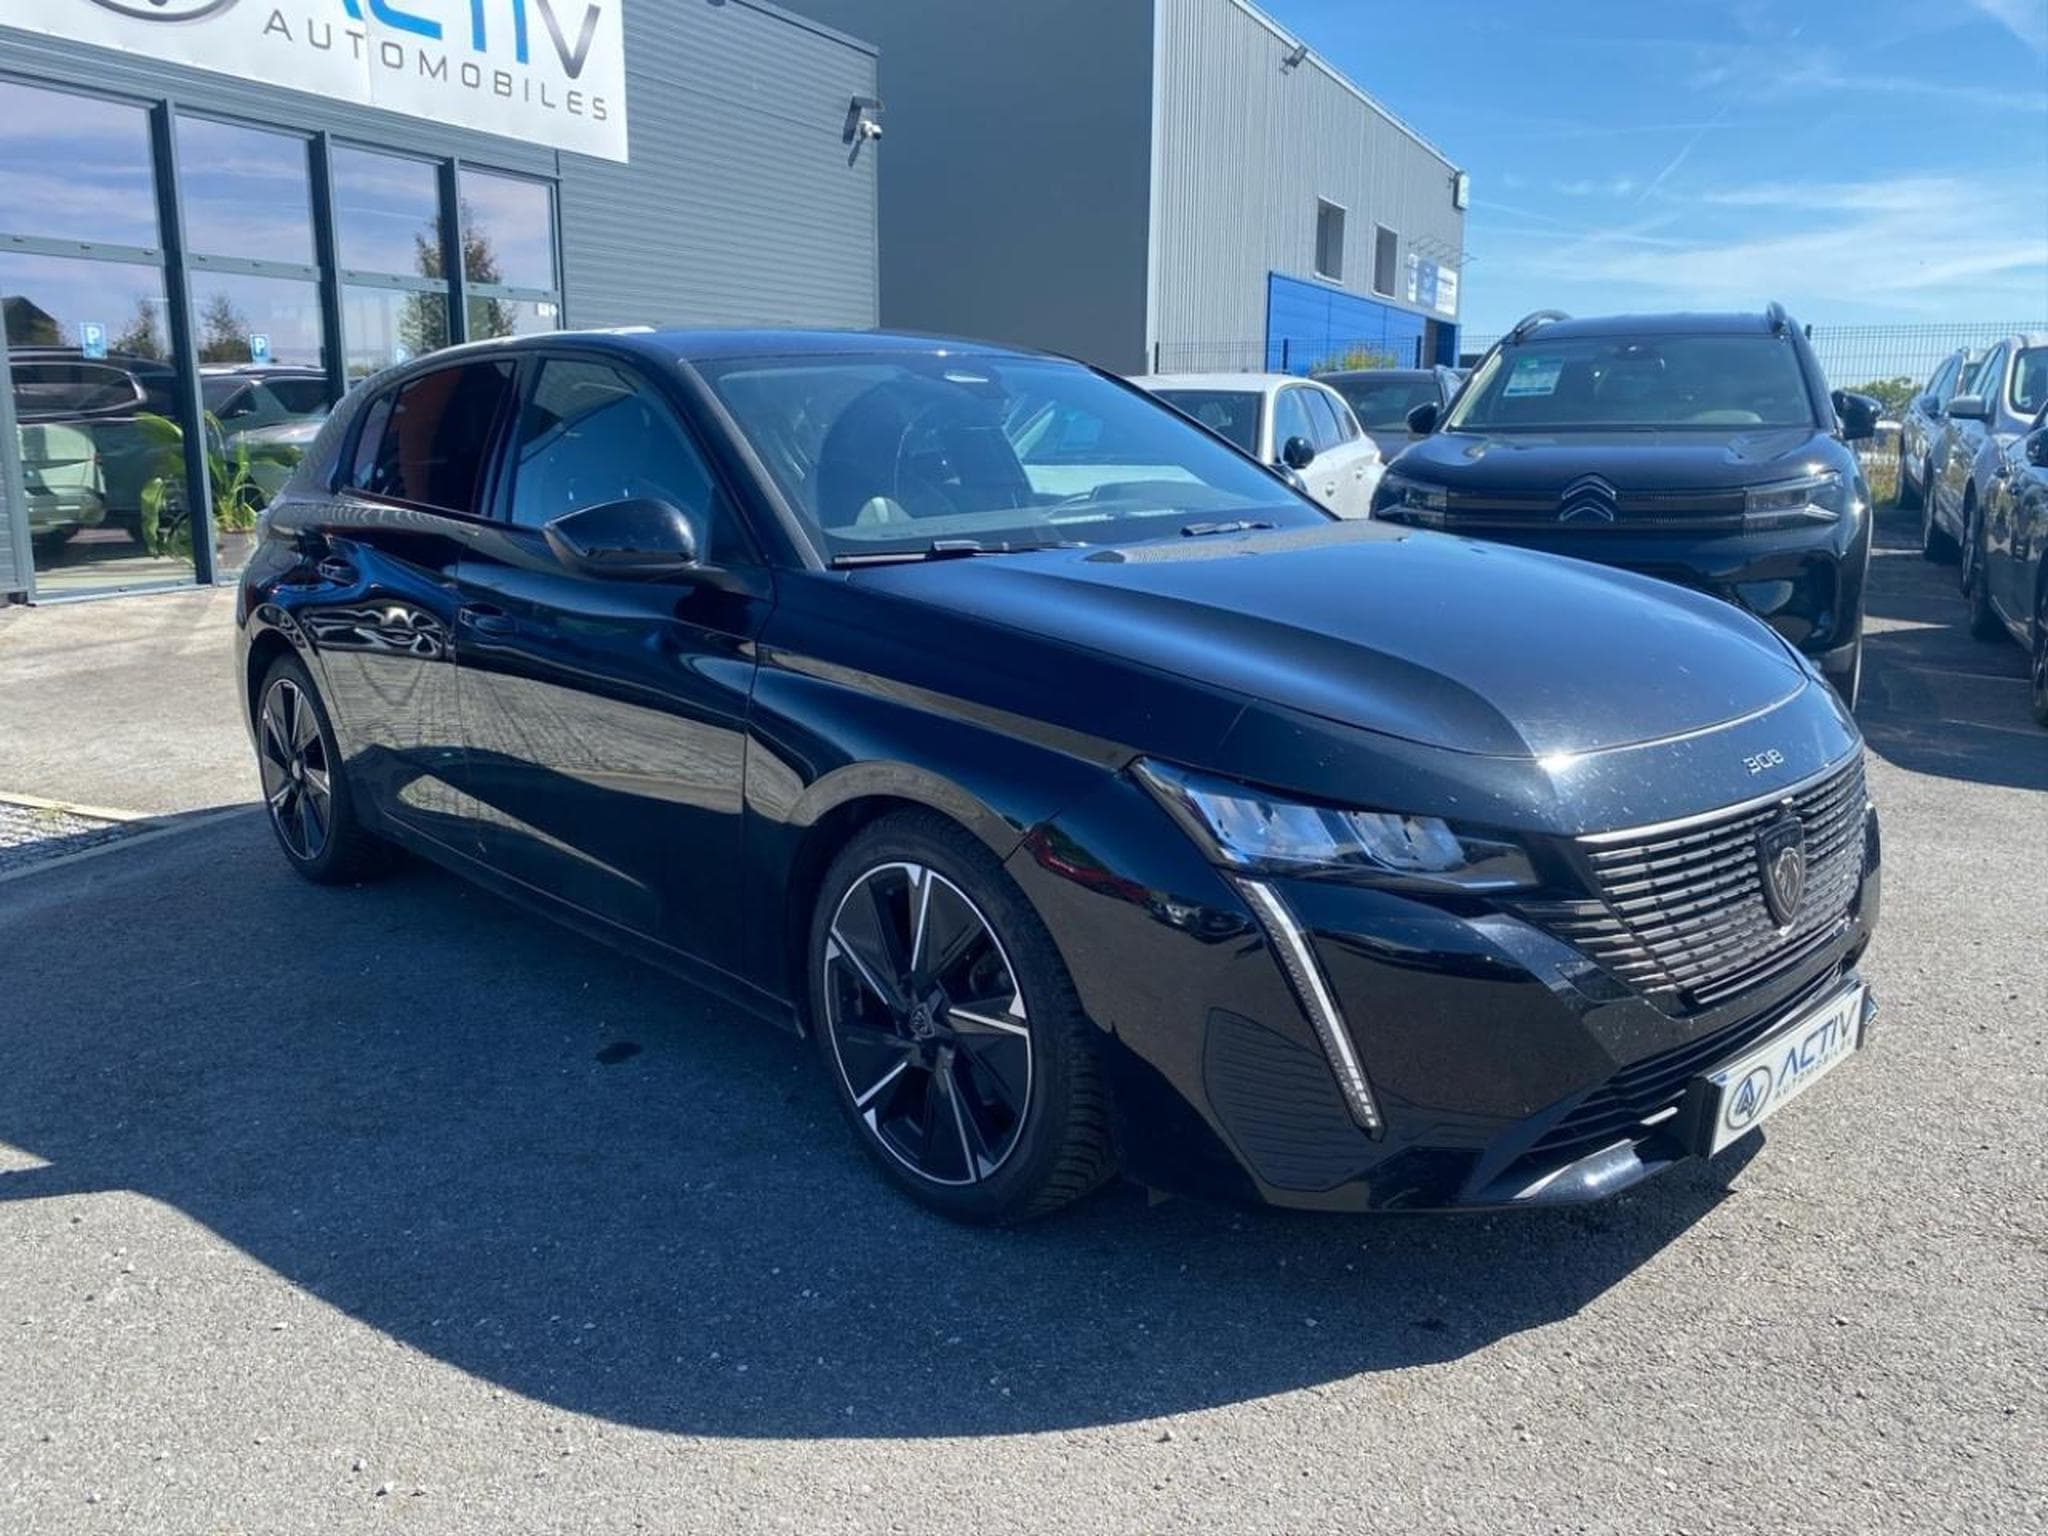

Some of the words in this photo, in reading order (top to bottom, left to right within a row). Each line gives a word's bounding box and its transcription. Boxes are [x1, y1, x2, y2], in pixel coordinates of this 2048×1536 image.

[263, 9, 607, 121] AUTOMOBILES
[1742, 748, 1784, 776] 308
[1777, 1001, 1857, 1088] ACTIV
